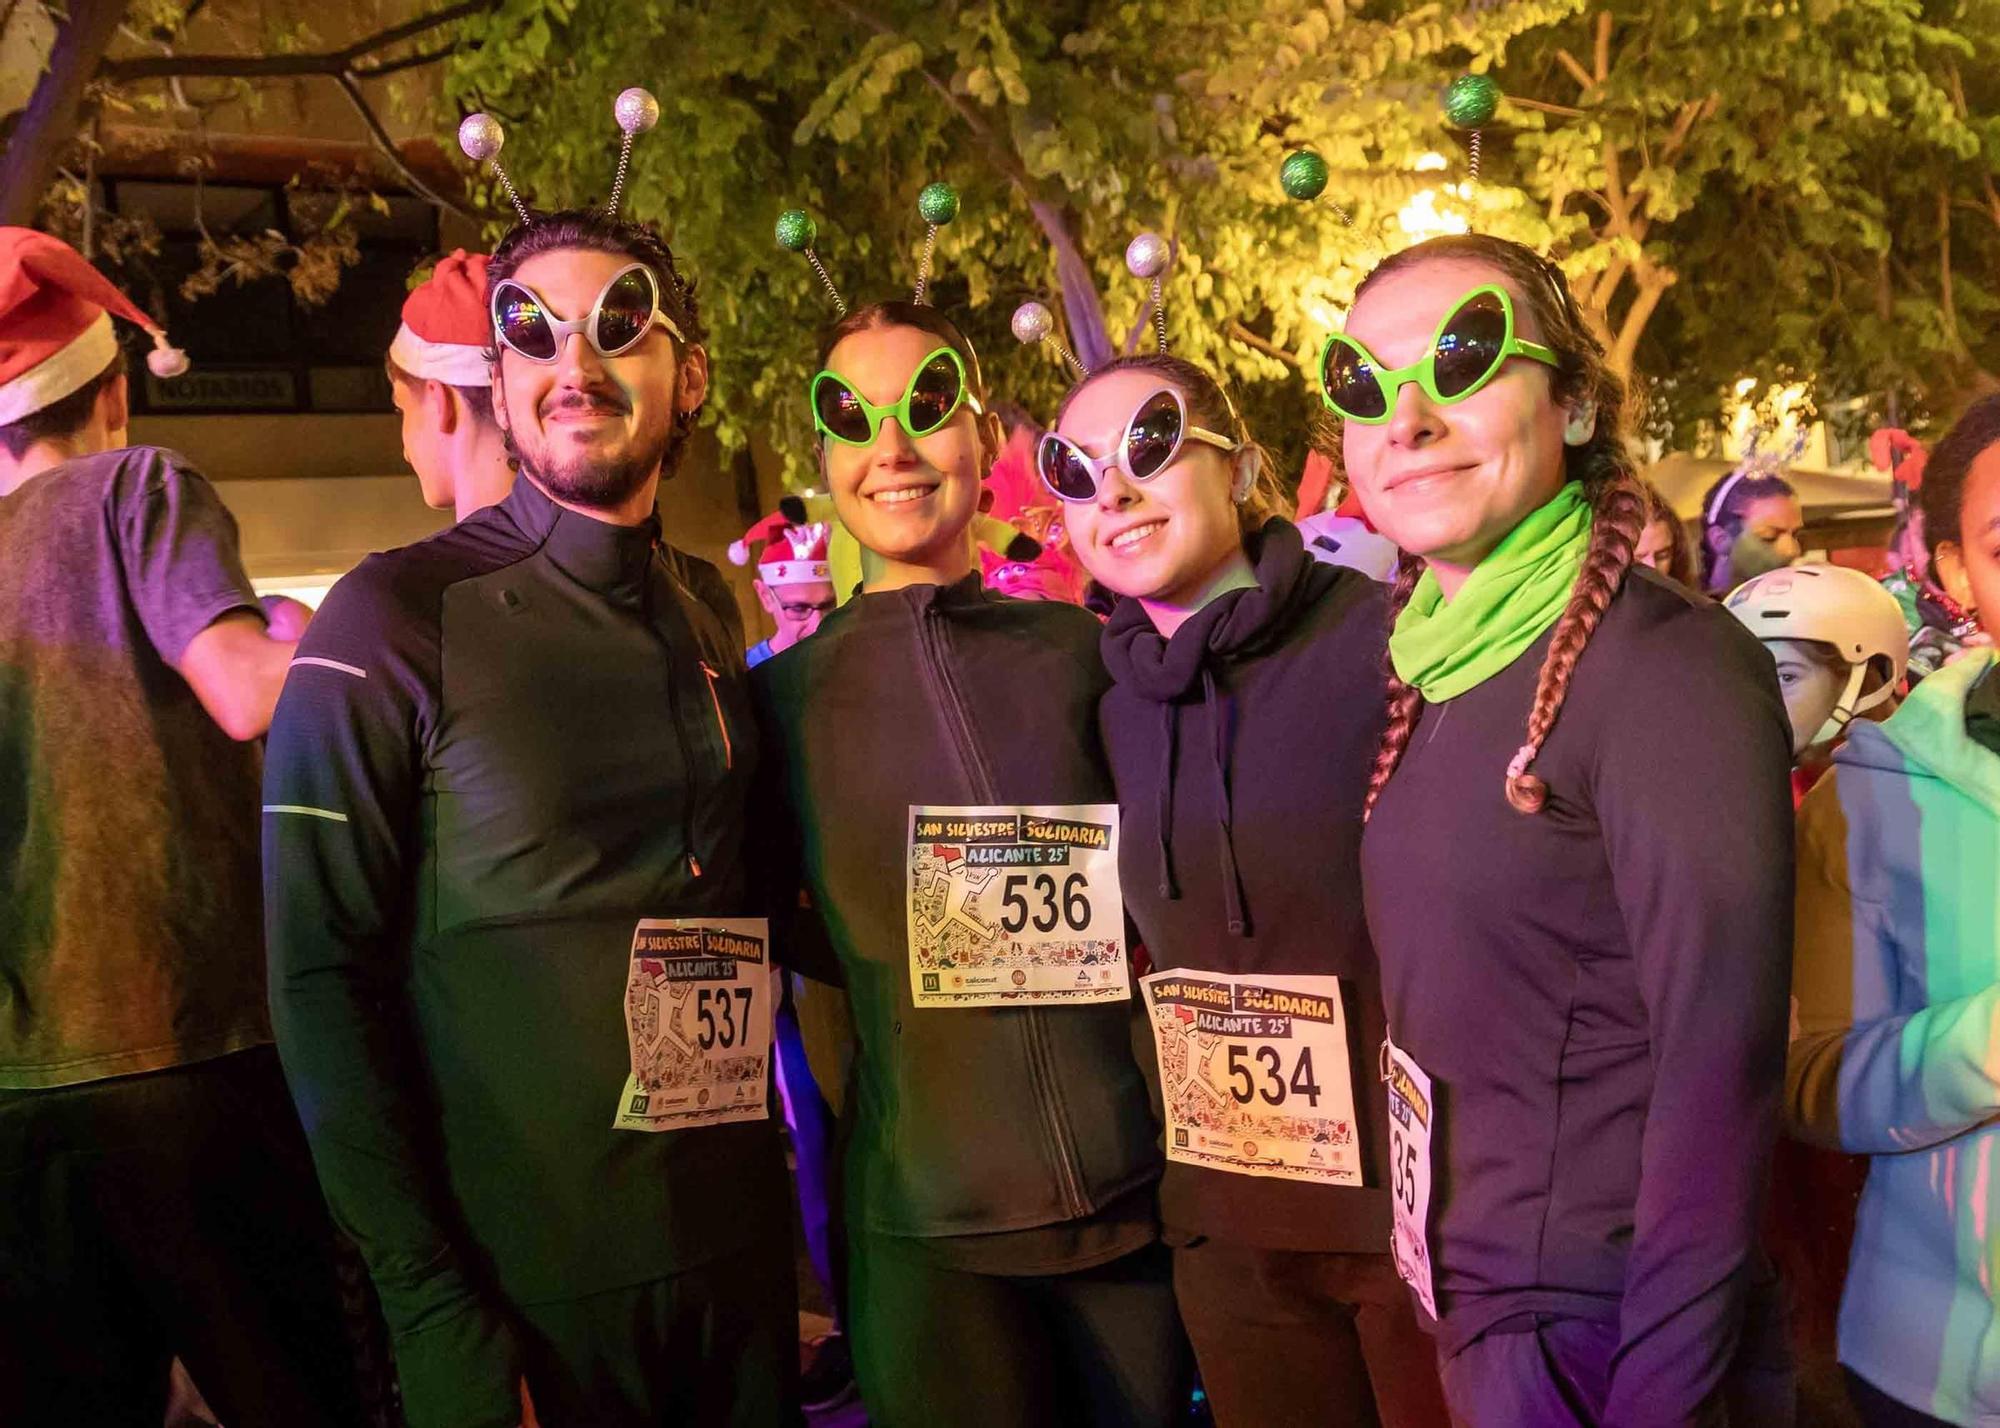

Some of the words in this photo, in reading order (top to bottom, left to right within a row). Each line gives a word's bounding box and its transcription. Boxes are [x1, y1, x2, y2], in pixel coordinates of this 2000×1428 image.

[917, 822, 942, 837] SAN
[947, 822, 1016, 837] SILVESTRE
[1026, 821, 1107, 845] SOLIDARIA
[968, 848, 1042, 863] ALICANTE
[1048, 846, 1068, 862] 25'
[1001, 872, 1092, 933] 536
[650, 935, 700, 950] SILVESTRE
[707, 935, 761, 959] SOLIDARIA
[668, 961, 719, 977] ALICANTE
[1154, 984, 1181, 998] SAN
[1183, 984, 1231, 1006] SILVESTRE
[1242, 989, 1330, 1018] SOLIDARIA
[698, 987, 753, 1050] 537
[1199, 1014, 1263, 1034] ALICANTE
[1269, 1016, 1289, 1034] 25'
[1228, 1044, 1321, 1107] 534
